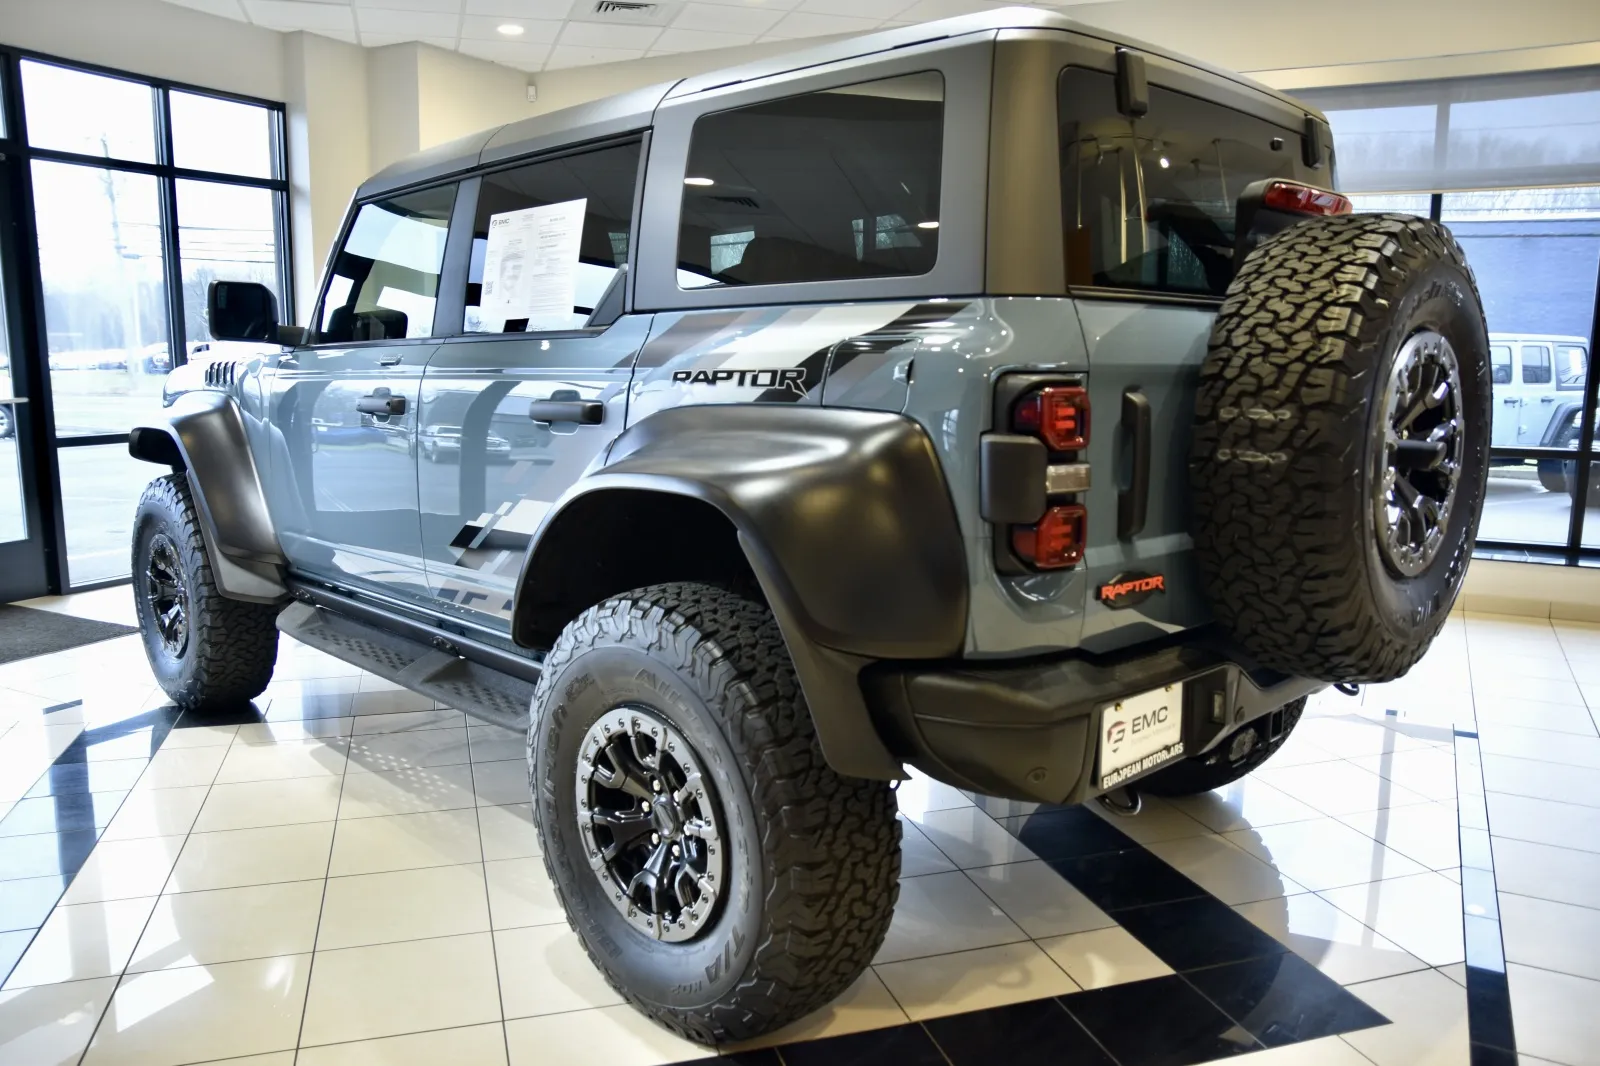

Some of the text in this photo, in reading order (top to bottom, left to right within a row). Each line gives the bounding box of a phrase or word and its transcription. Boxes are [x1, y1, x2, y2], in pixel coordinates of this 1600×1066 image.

[671, 367, 810, 400] RAPTOR
[1101, 575, 1164, 600] RAPTOR
[1131, 705, 1169, 735] EMC
